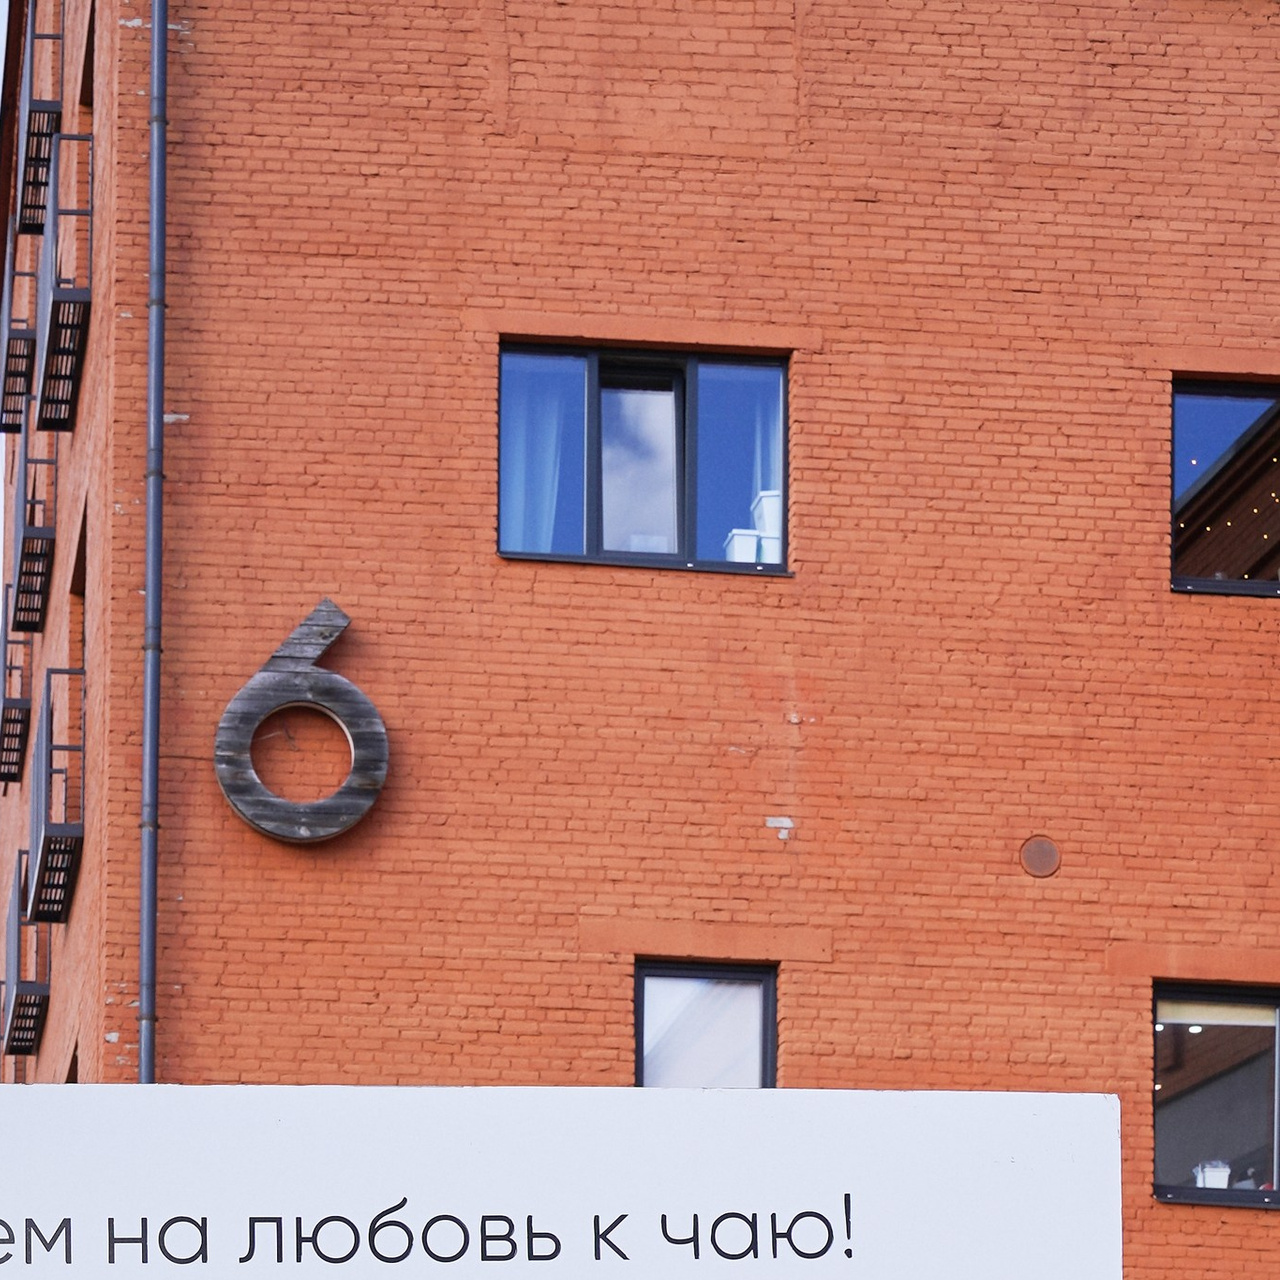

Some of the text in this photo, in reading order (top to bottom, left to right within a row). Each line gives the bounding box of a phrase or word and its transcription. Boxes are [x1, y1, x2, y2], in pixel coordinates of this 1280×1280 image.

[215, 597, 390, 844] 6
[107, 1215, 208, 1265] на
[238, 1196, 562, 1264] любовь
[593, 1213, 630, 1261] к
[660, 1193, 853, 1261] чаю!
